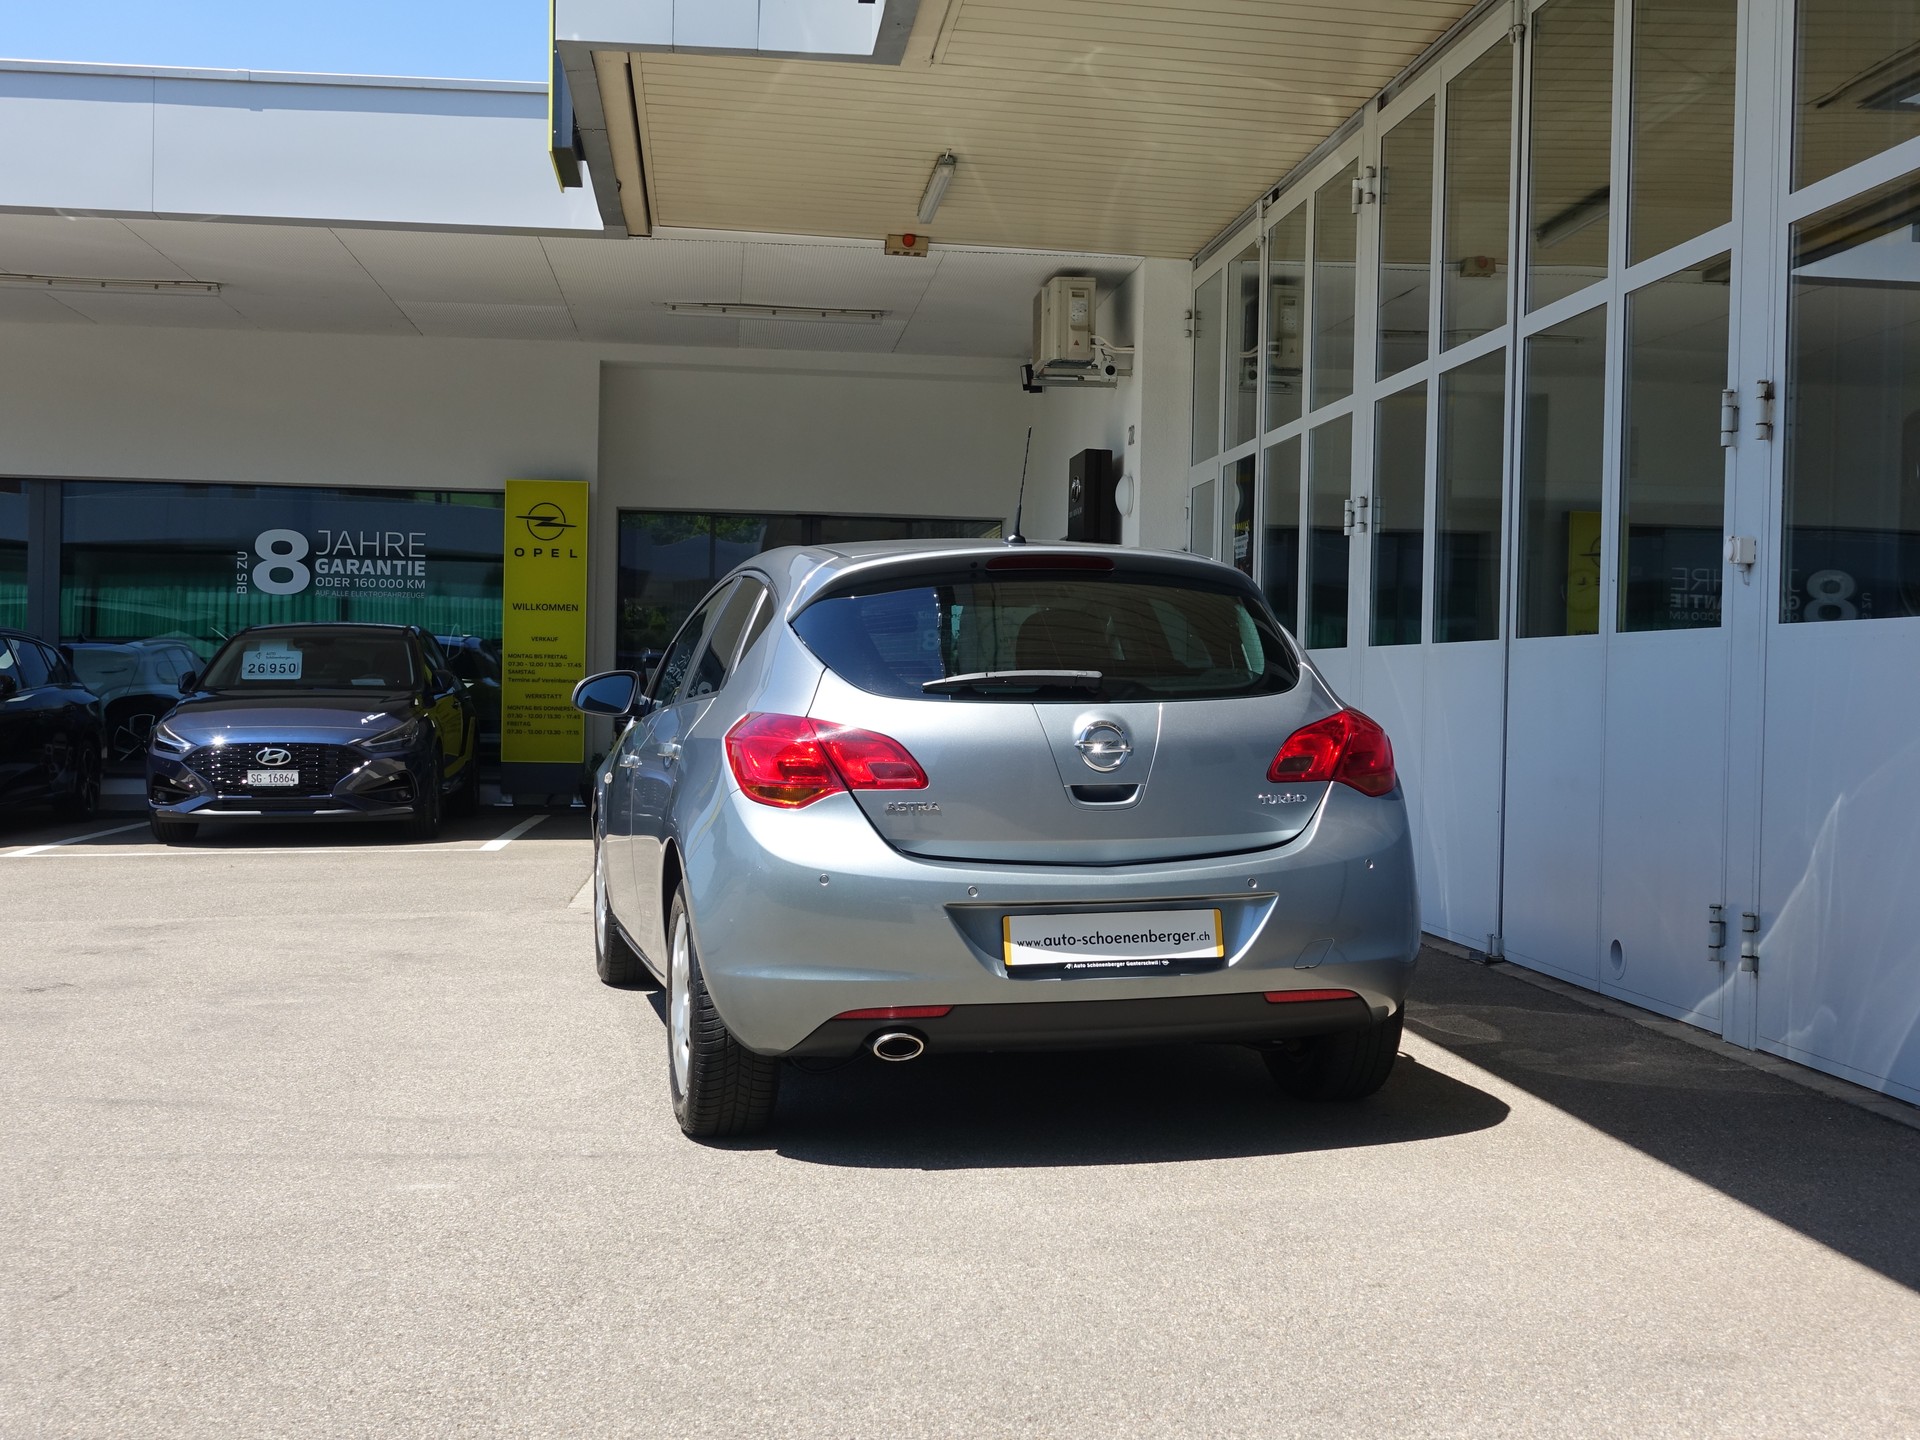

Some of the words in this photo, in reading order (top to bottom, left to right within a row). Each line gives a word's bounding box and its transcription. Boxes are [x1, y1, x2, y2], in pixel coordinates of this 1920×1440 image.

[315, 530, 427, 558] JAHRE
[514, 547, 578, 558] OPEL
[236, 551, 248, 570] ZU
[252, 528, 311, 596] 8
[314, 558, 426, 577] GARANTIE
[236, 573, 248, 594] BIS
[315, 577, 350, 588] ODER
[354, 578, 377, 588] 160
[378, 578, 404, 589] 000
[407, 579, 426, 589] KM
[315, 589, 330, 597] AUF
[332, 590, 349, 598] ALLE
[350, 590, 425, 599] ELEKTROFAHRZEUGE
[512, 603, 579, 612] WILLKOMMEN
[251, 773, 262, 784] SG
[268, 773, 295, 784] 16864
[1258, 793, 1308, 805] TURBO
[886, 801, 941, 812] ASTRA
[1017, 929, 1211, 947] www.auto-schoenenberger.ch
